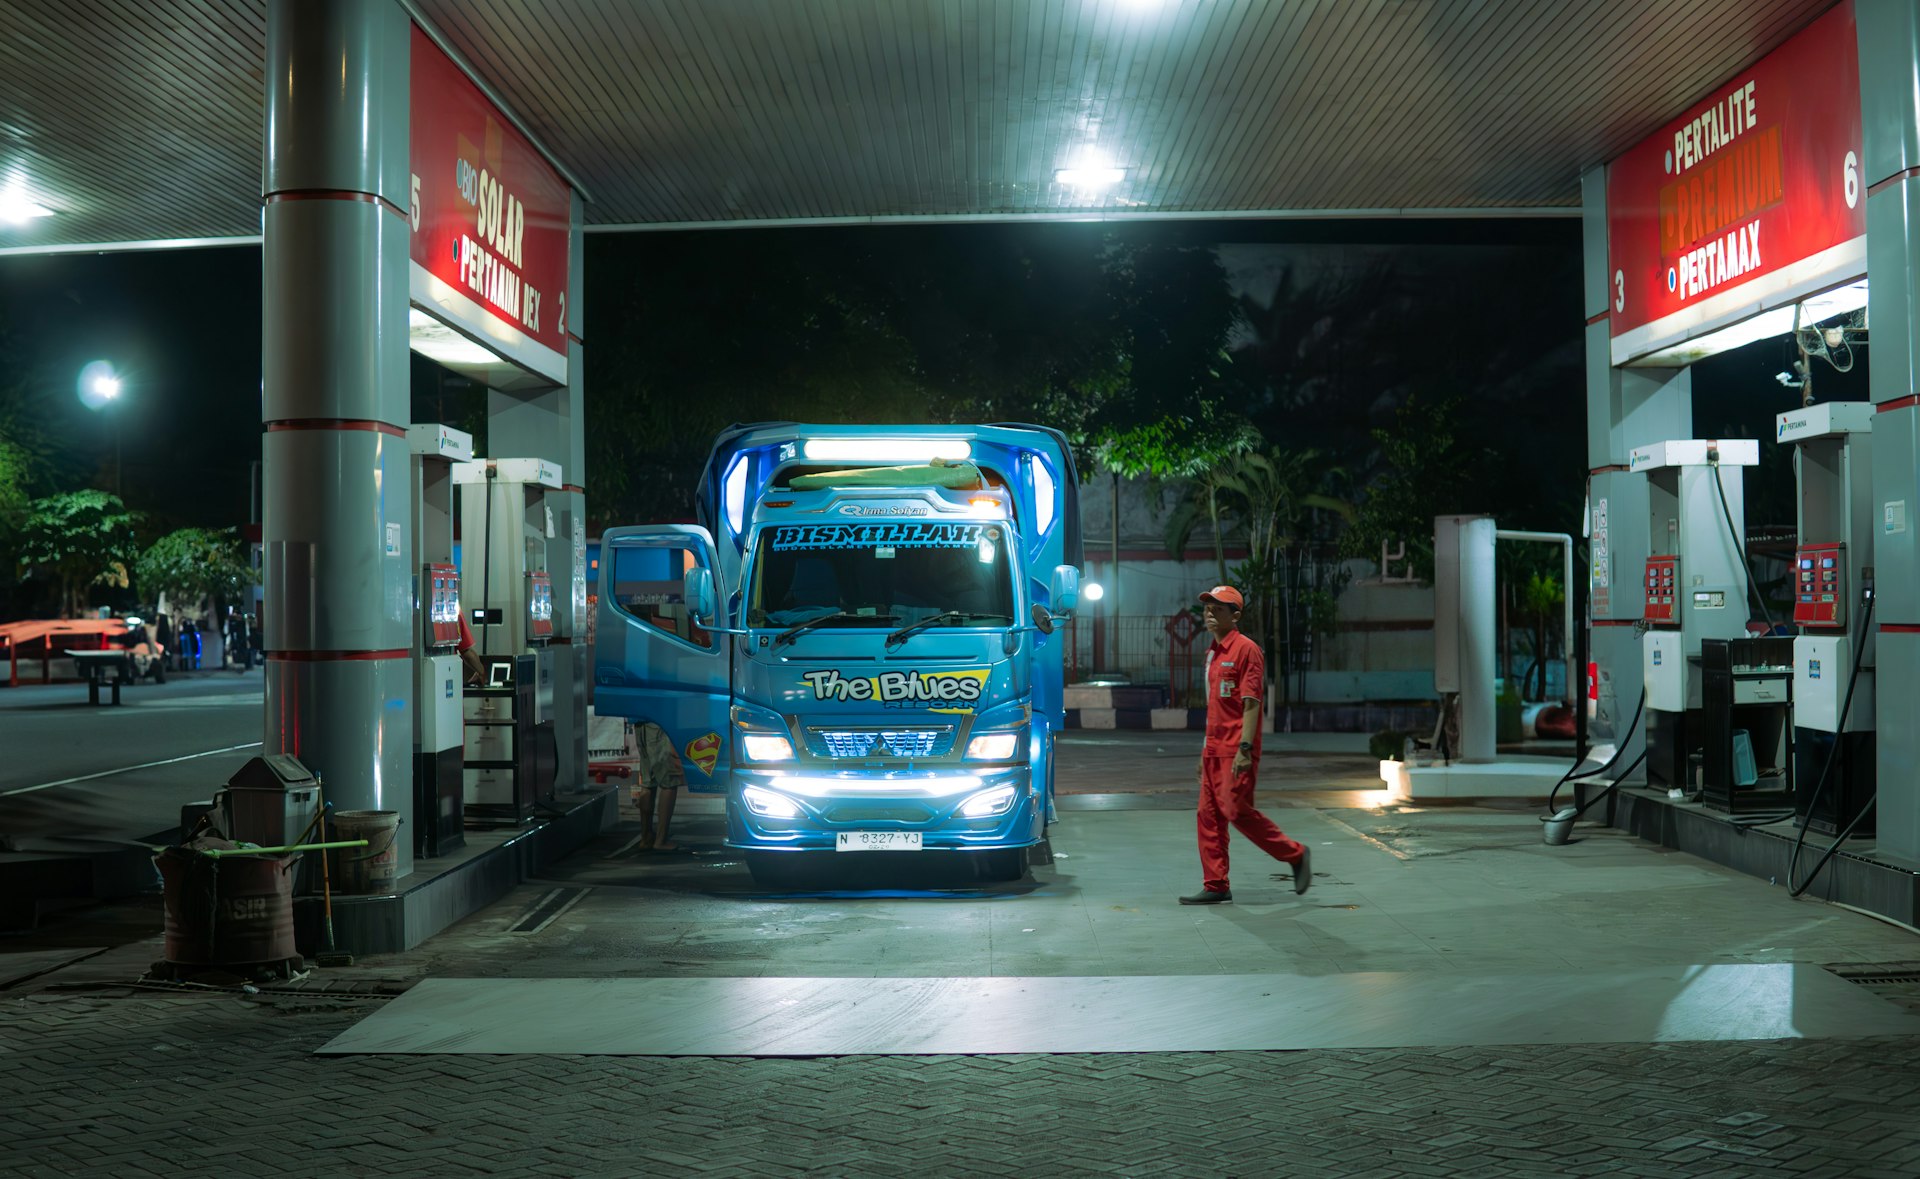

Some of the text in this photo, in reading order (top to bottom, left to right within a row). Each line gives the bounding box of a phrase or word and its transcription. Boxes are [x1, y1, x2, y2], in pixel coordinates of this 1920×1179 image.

[1674, 80, 1757, 175] PERTALITE
[411, 173, 420, 233] 5
[1677, 127, 1782, 250] PREMIUM
[1843, 150, 1858, 209] 6
[477, 168, 524, 270] SOLAR
[1679, 219, 1761, 300] PERTAMAX
[522, 282, 541, 333] DEX
[558, 291, 565, 335] 2
[1615, 269, 1625, 314] 3
[863, 506, 887, 515] Irma
[772, 525, 984, 548] BISMILLAH
[803, 668, 981, 702] The Blues
[883, 700, 979, 710] REBORN
[840, 833, 919, 845] N 8327 YJ
